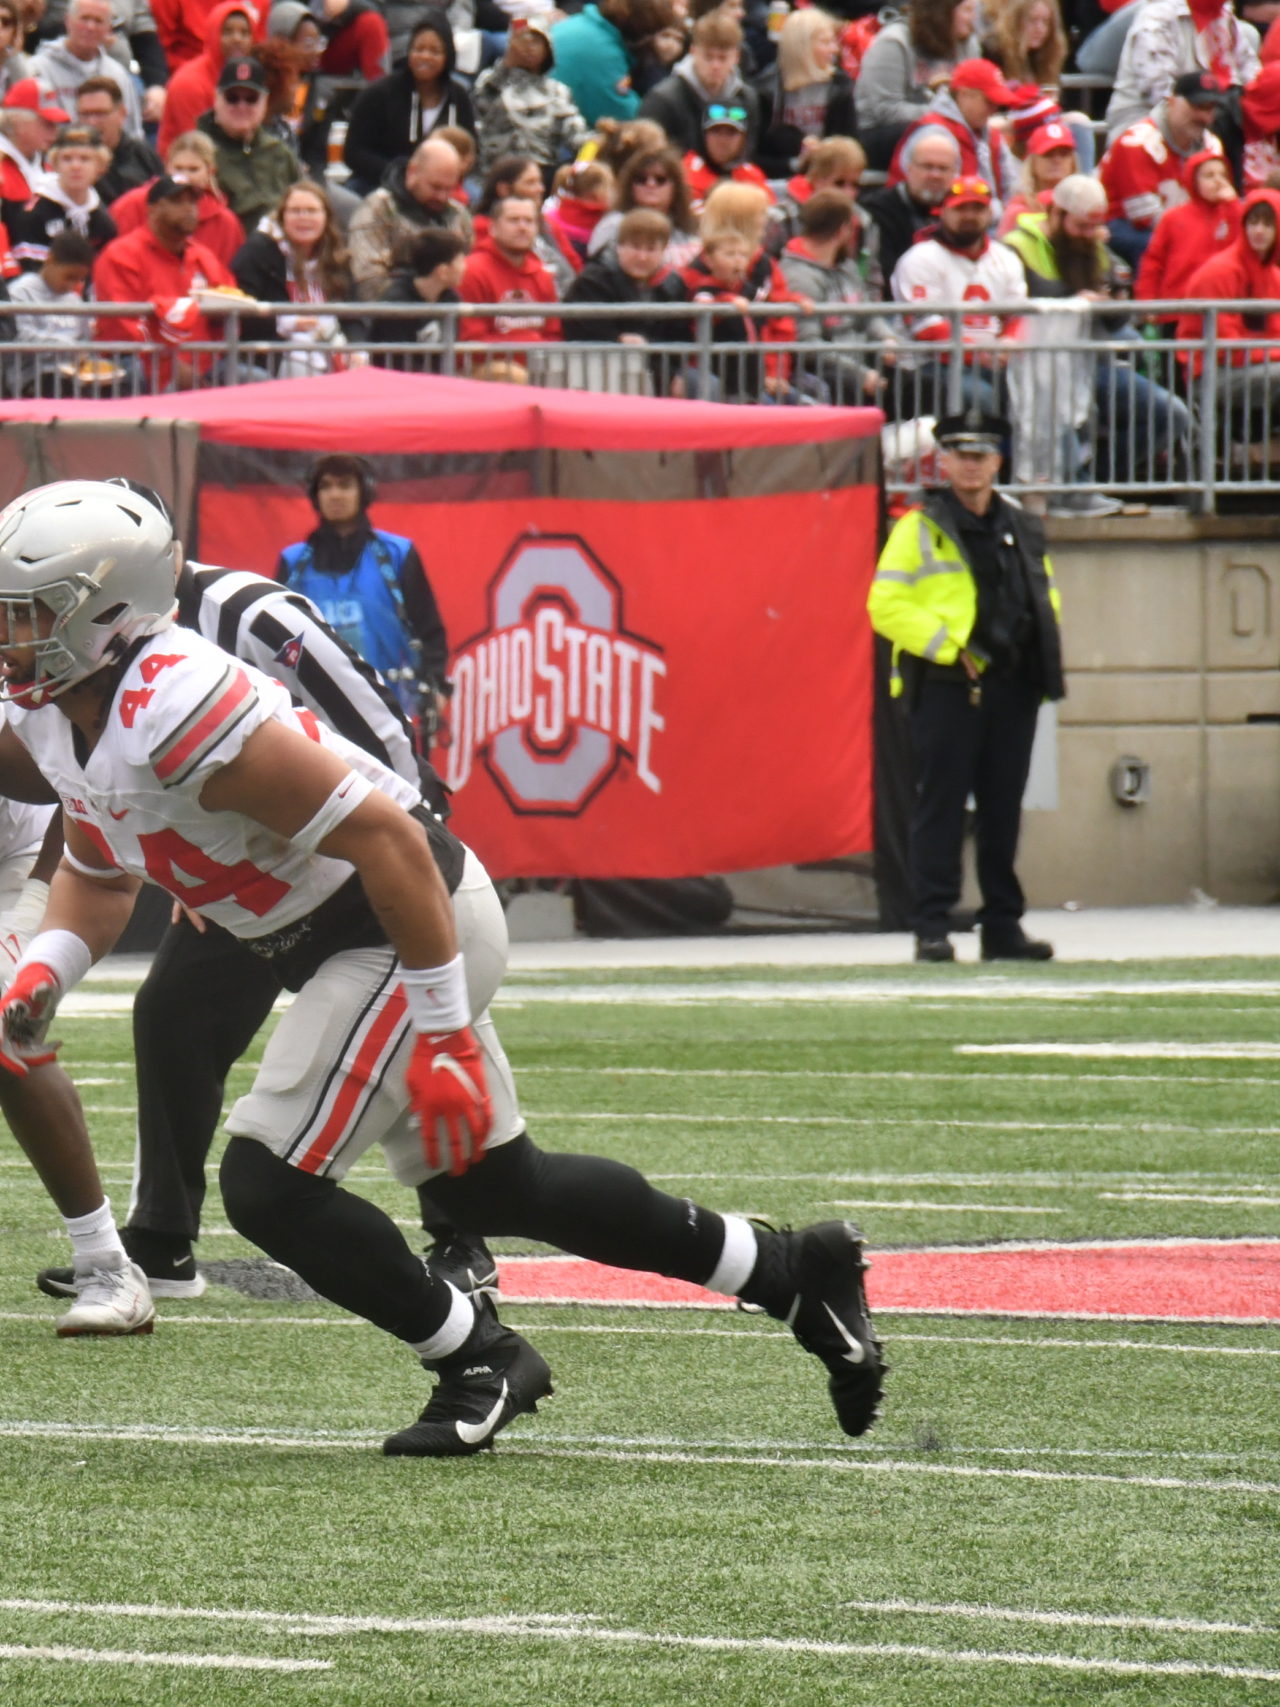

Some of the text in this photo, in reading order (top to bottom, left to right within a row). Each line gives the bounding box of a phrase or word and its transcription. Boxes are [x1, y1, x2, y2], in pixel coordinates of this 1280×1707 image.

[119, 653, 188, 729] 44
[449, 609, 667, 794] OHIO STATE
[463, 1365, 493, 1377] ALPHA
